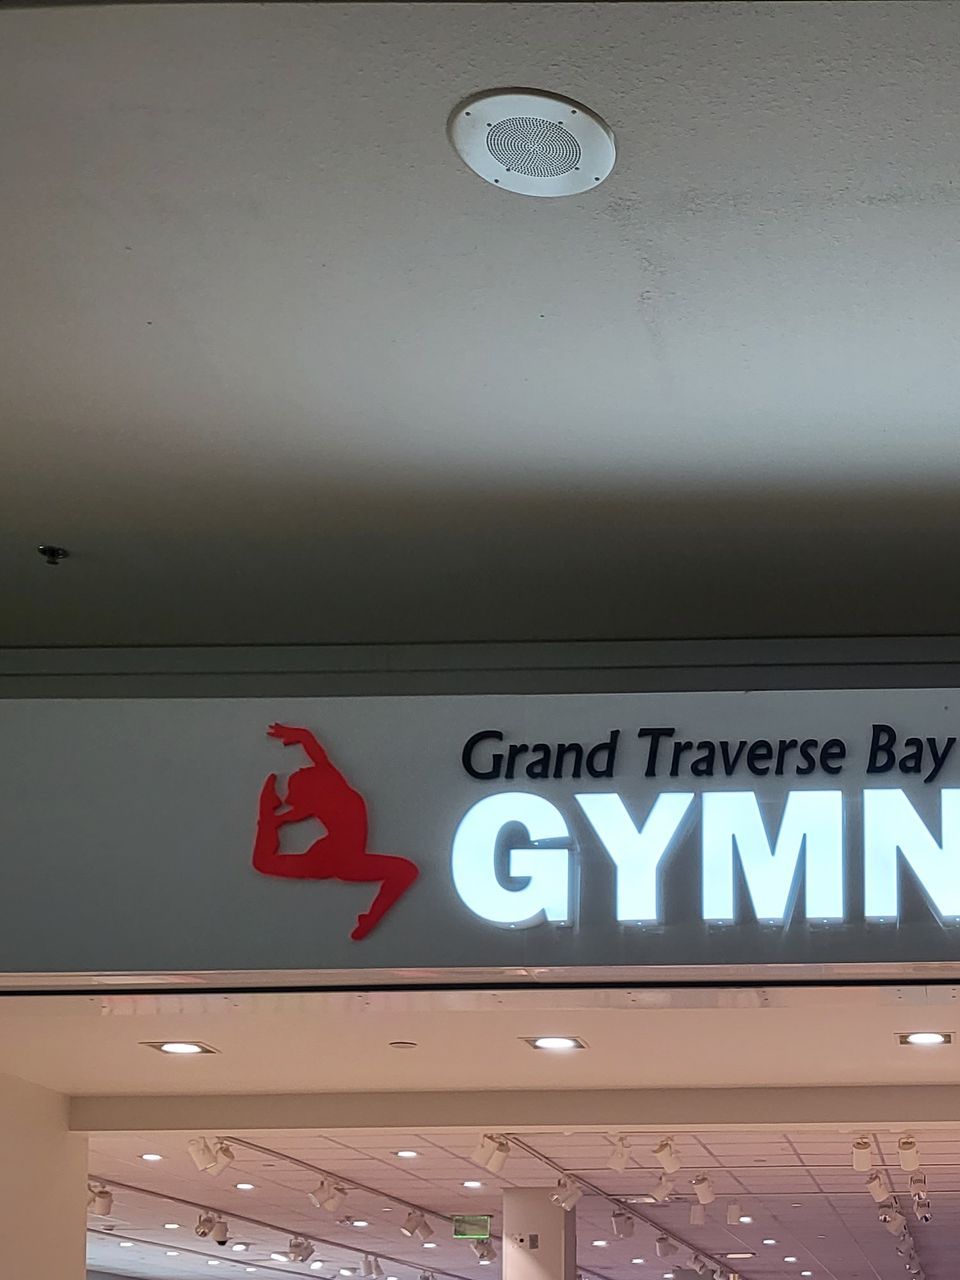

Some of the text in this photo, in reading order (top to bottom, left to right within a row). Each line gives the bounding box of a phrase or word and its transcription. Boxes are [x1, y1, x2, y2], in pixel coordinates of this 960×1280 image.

[462, 724, 957, 783] Grand Traverse Bay
